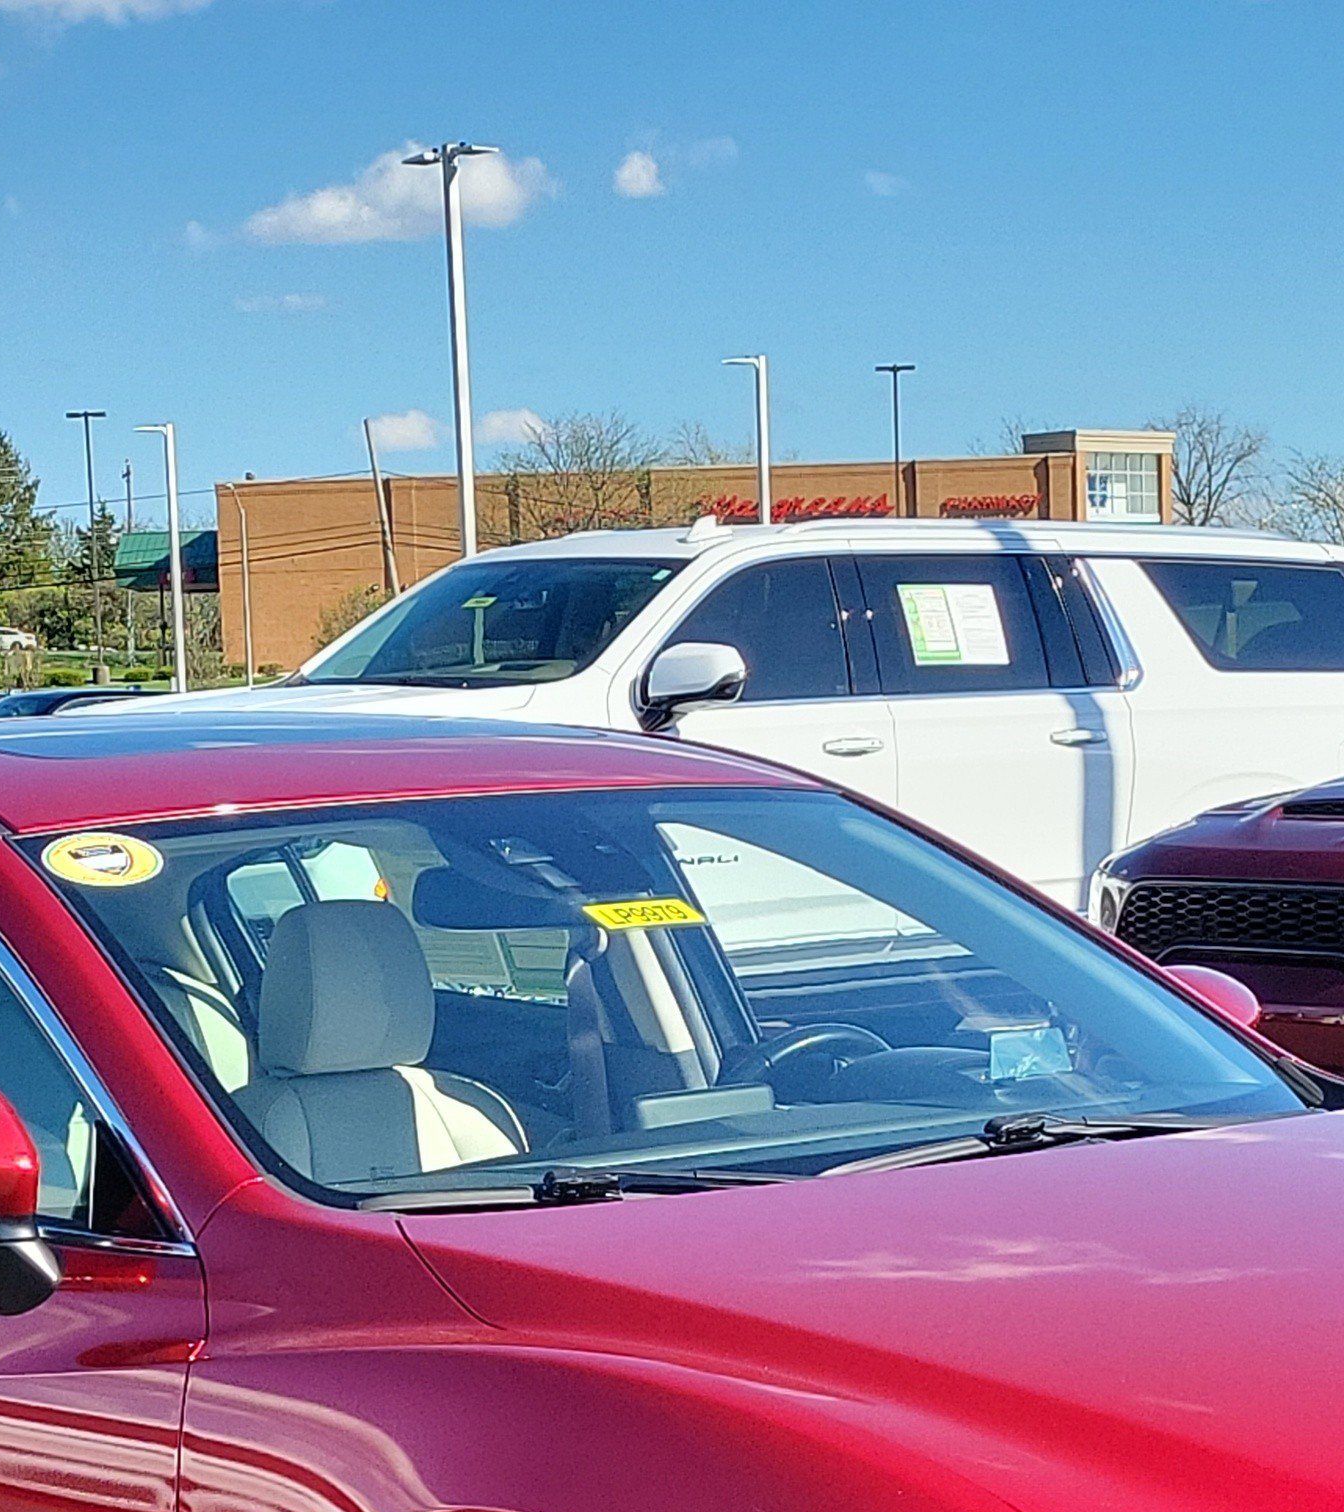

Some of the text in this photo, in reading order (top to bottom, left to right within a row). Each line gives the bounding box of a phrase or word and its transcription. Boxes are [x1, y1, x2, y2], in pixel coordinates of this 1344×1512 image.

[700, 493, 896, 522] Wagreens
[946, 493, 1042, 511] PHARMACY
[678, 854, 739, 866] NALI
